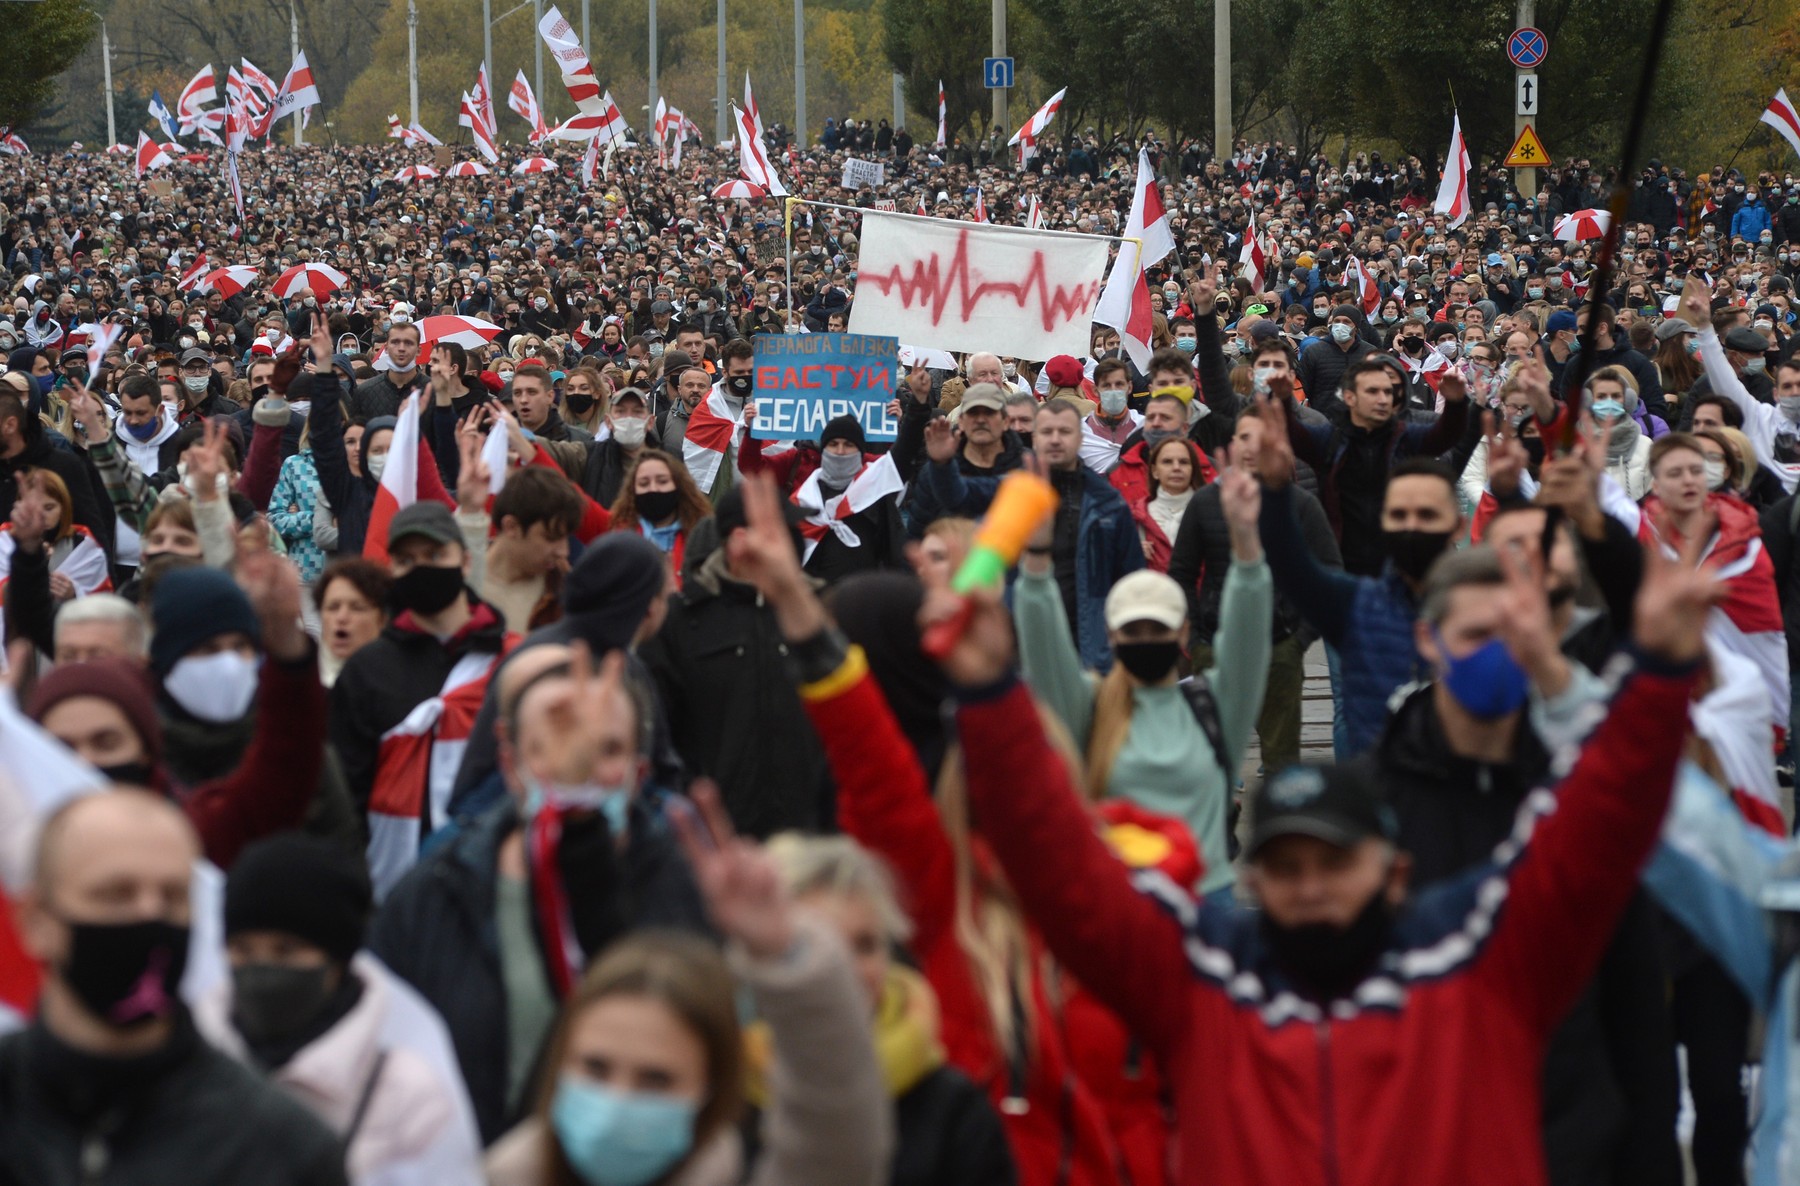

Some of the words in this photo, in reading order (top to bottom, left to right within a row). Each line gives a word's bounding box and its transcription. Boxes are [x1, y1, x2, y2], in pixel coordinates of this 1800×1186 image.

[756, 335, 833, 355] ПЕРАМОГА
[756, 361, 893, 394] БАСТУЙ,
[752, 397, 898, 436] БЕЛАРУСЬ
